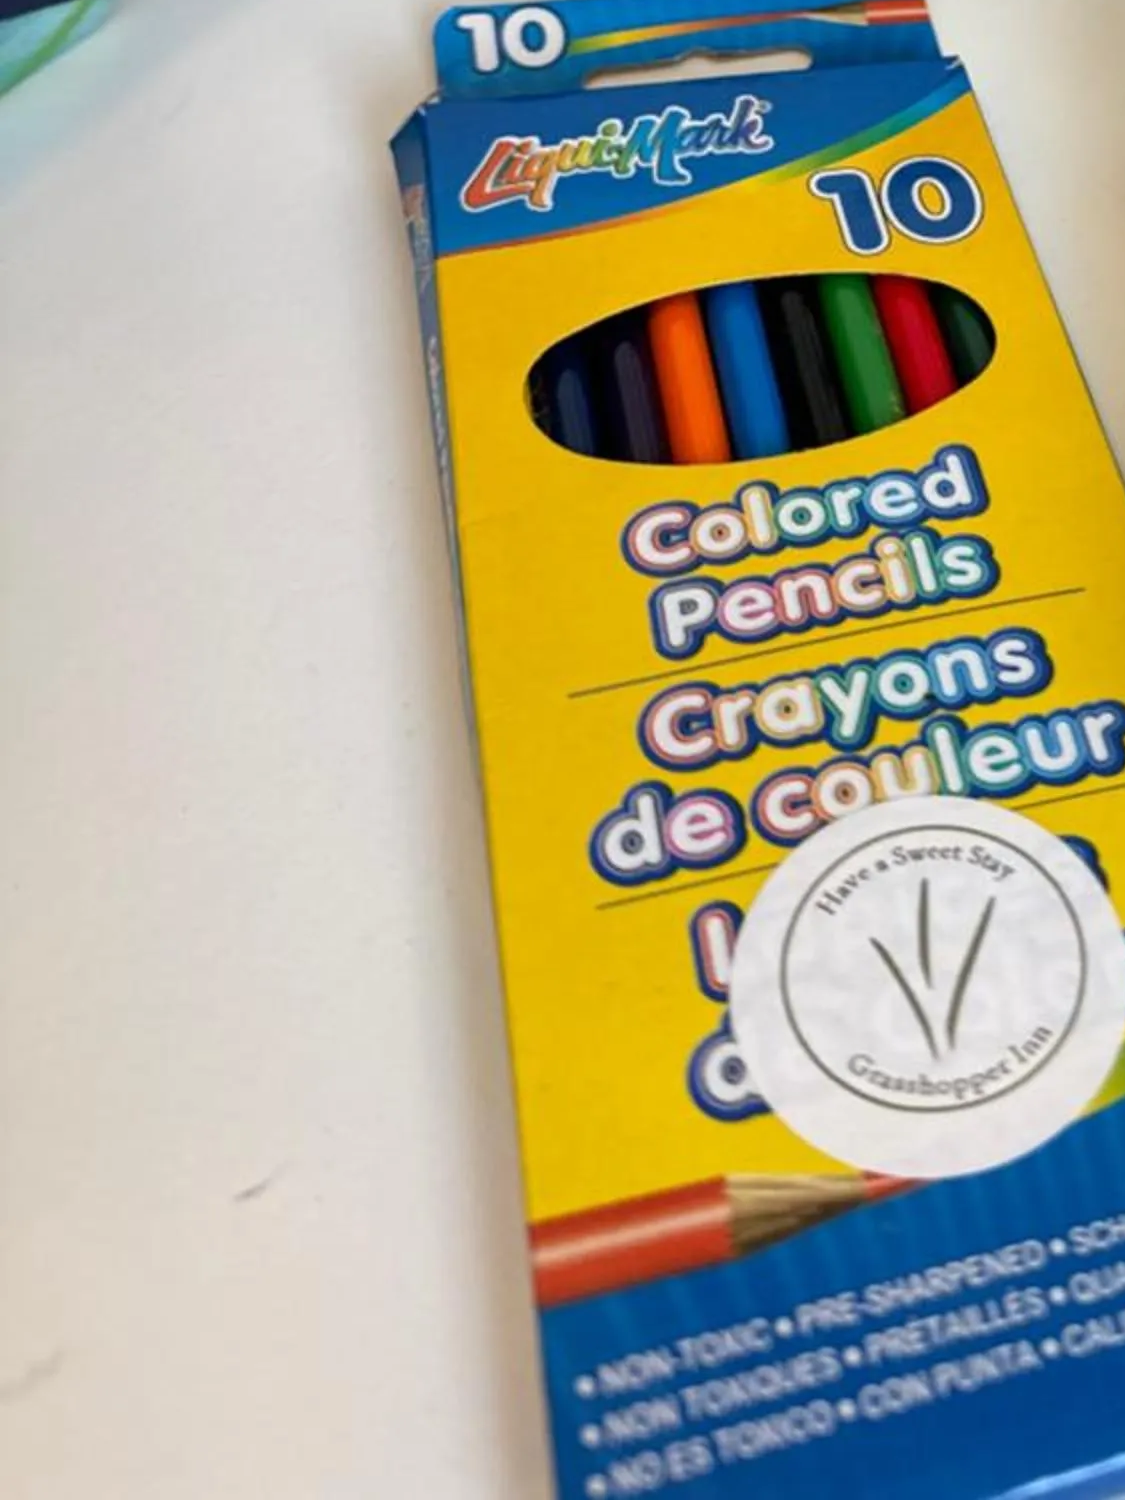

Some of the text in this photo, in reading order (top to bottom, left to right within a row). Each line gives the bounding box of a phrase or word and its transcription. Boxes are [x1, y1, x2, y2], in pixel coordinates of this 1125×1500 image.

[455, 5, 569, 73] 10
[808, 155, 984, 255] 10
[624, 446, 986, 573] Colored
[651, 530, 996, 657] Pencils
[641, 630, 1050, 769] Crayons
[593, 784, 744, 883] de
[814, 845, 1016, 916] Have a Sweet Stay
[846, 1025, 1054, 1100] Grasshopper Inn
[597, 1317, 773, 1397] NON-TOXIC
[794, 1238, 1047, 1334] PRE-SHARPENED
[601, 1393, 682, 1448] NON
[679, 1345, 844, 1422] TOXIQUES
[608, 1450, 665, 1498] NO
[661, 1435, 715, 1482] ES
[857, 1369, 935, 1420] CON
[930, 1339, 1044, 1397] PUNTA
